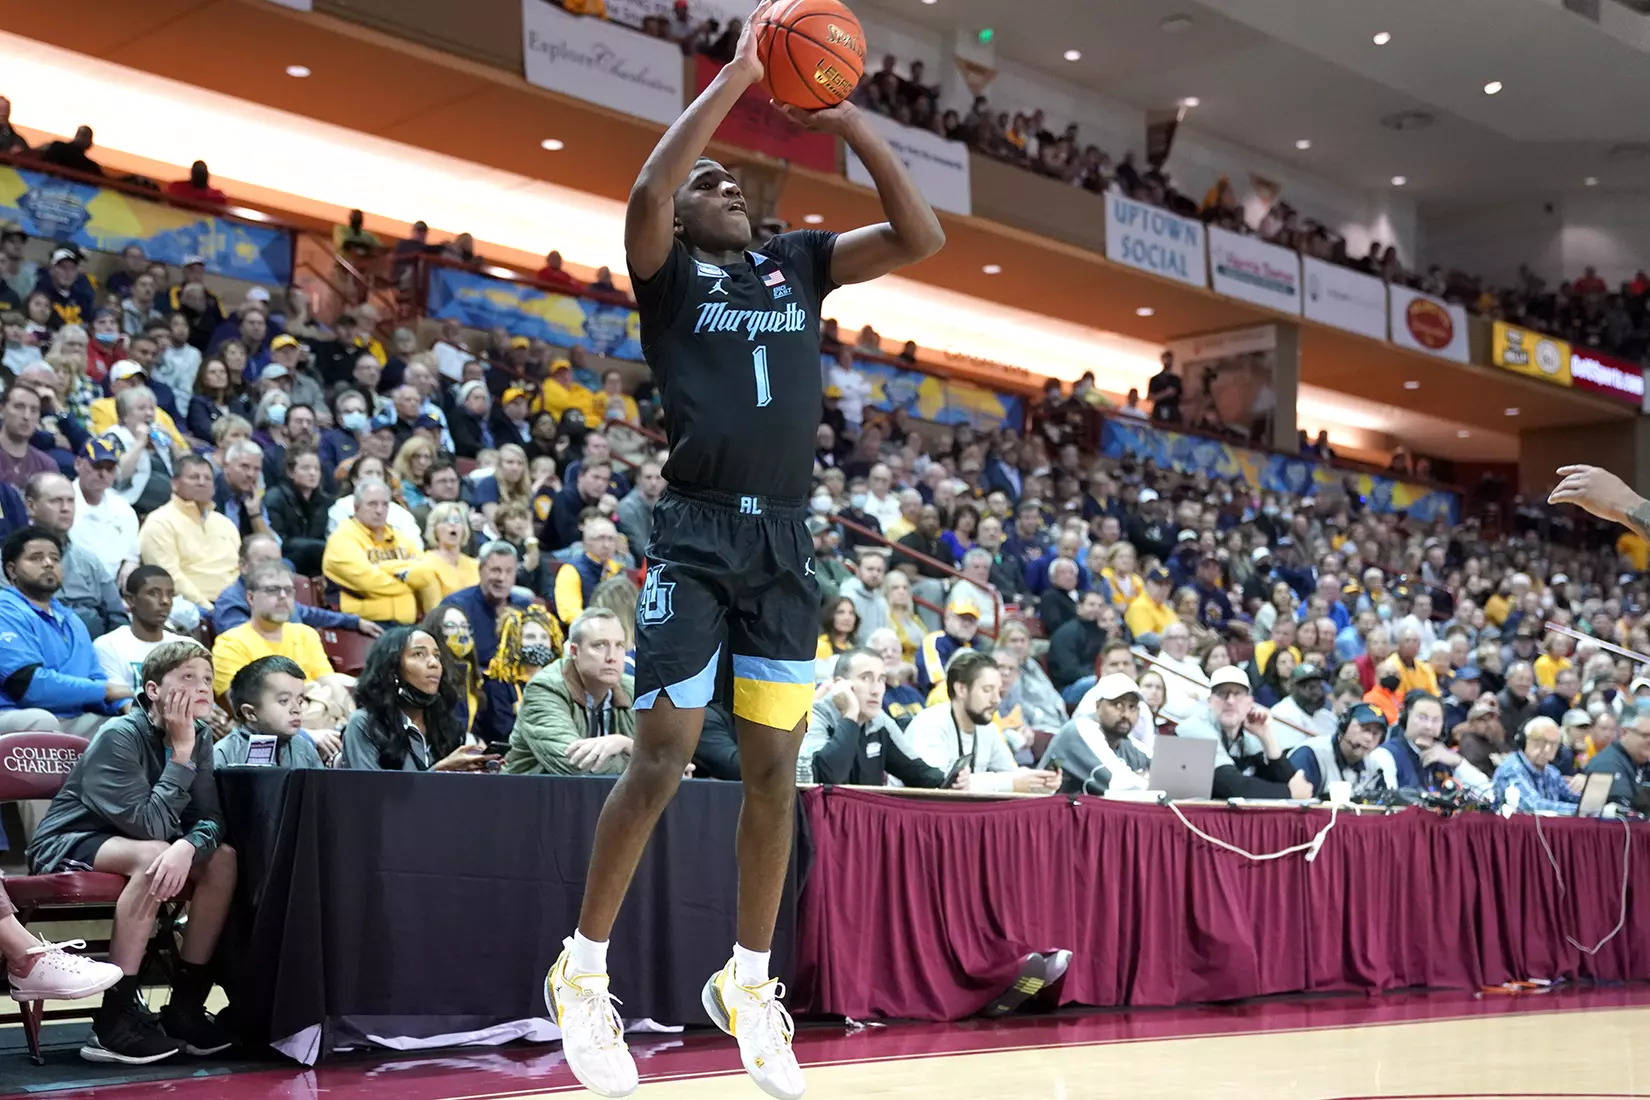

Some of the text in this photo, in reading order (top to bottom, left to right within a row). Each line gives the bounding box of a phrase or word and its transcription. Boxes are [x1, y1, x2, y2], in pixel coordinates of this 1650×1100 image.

[826, 24, 863, 57] SPALD
[816, 58, 853, 93] LEGAC
[1113, 199, 1197, 247] UPTOWN
[1121, 234, 1188, 278] SOCIAL
[694, 302, 806, 341] Marquette
[752, 345, 773, 407] 1
[740, 496, 762, 515] AL
[4, 755, 79, 774] CHARLEST
[12, 746, 77, 761] COLLEGE
